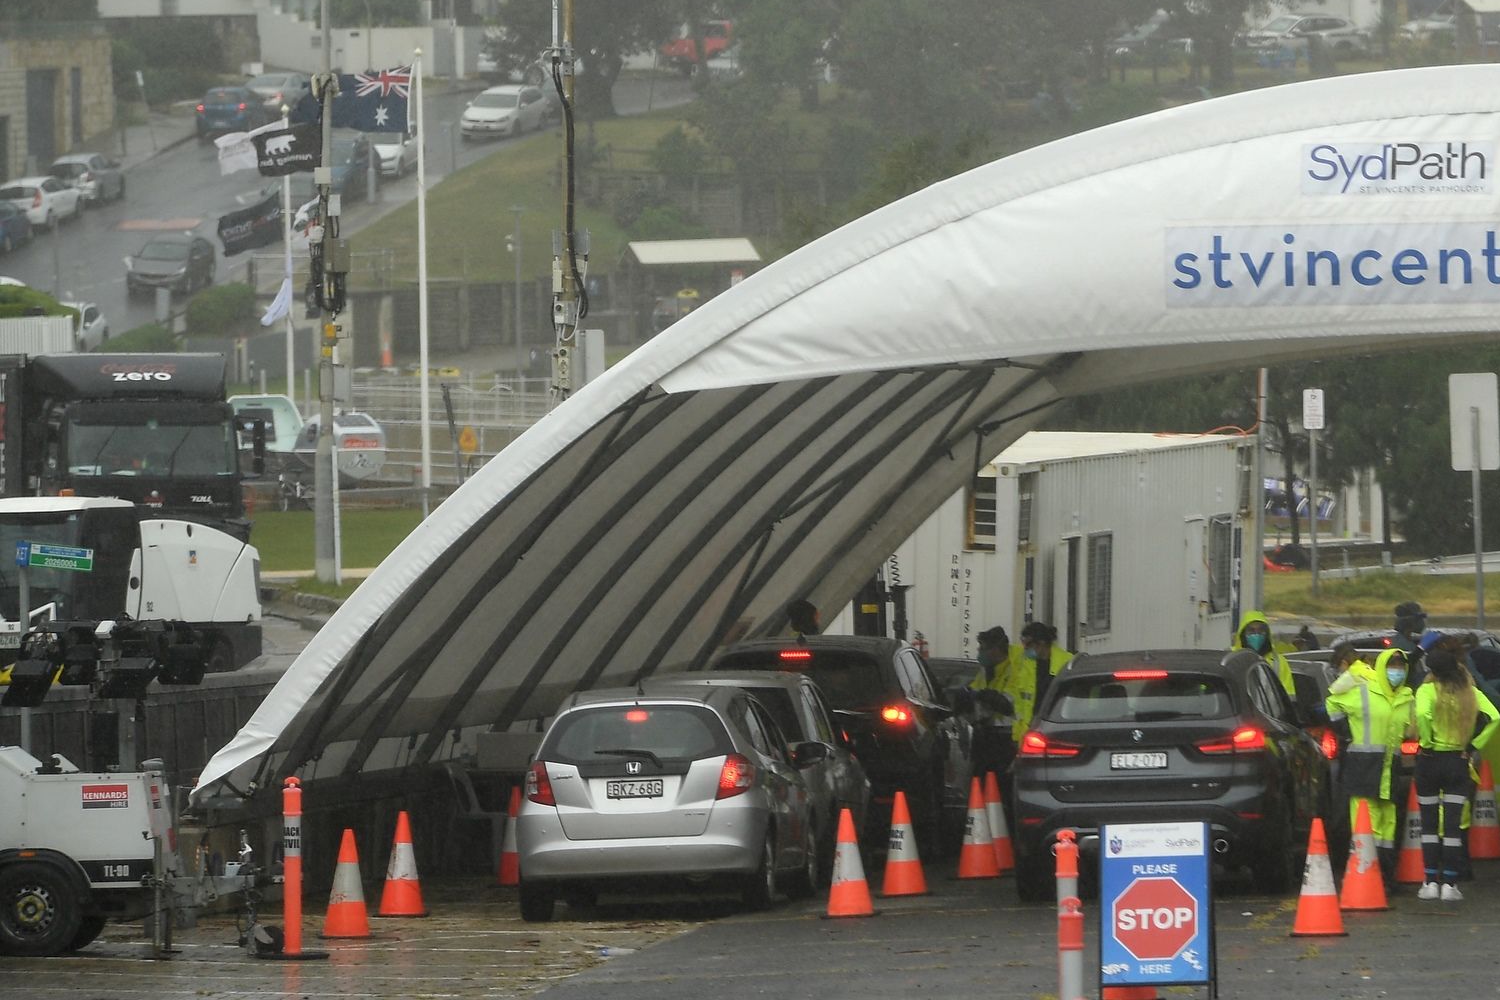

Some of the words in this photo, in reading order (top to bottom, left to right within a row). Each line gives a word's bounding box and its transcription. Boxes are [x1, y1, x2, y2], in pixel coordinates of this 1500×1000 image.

[1307, 142, 1486, 194] SydPath
[1428, 185, 1485, 193] PATHOLOGY
[112, 372, 172, 382] zero
[83, 790, 128, 800] KENNARDS
[1132, 863, 1178, 875] PLEASE
[1117, 907, 1194, 931] STOP
[1140, 964, 1173, 974] HERE
